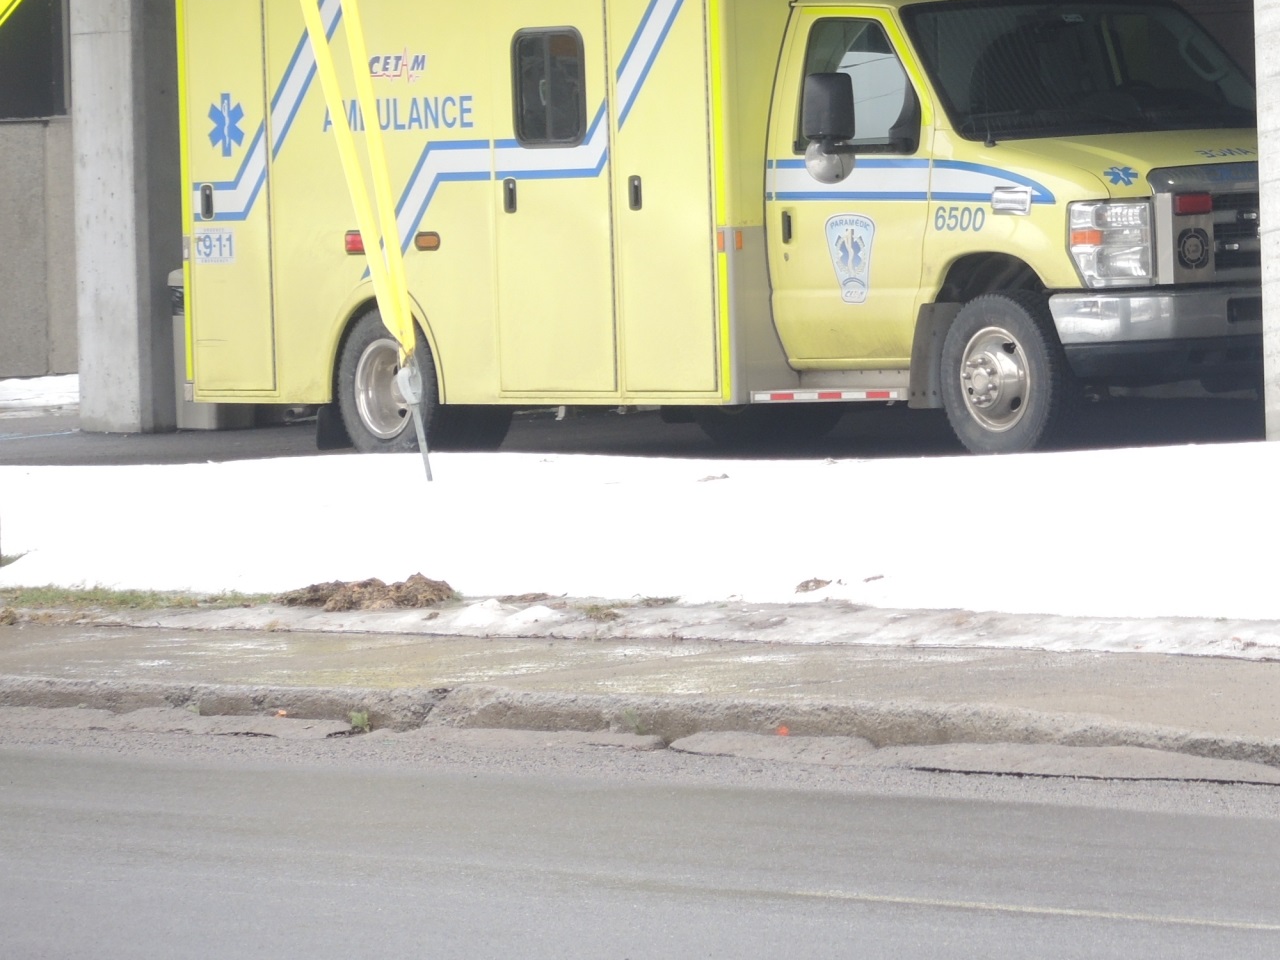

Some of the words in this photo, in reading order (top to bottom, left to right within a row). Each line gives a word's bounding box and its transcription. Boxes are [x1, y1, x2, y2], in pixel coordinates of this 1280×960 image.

[369, 48, 426, 82] CETAM
[323, 95, 474, 132] MULANCE
[935, 206, 986, 232] 6500
